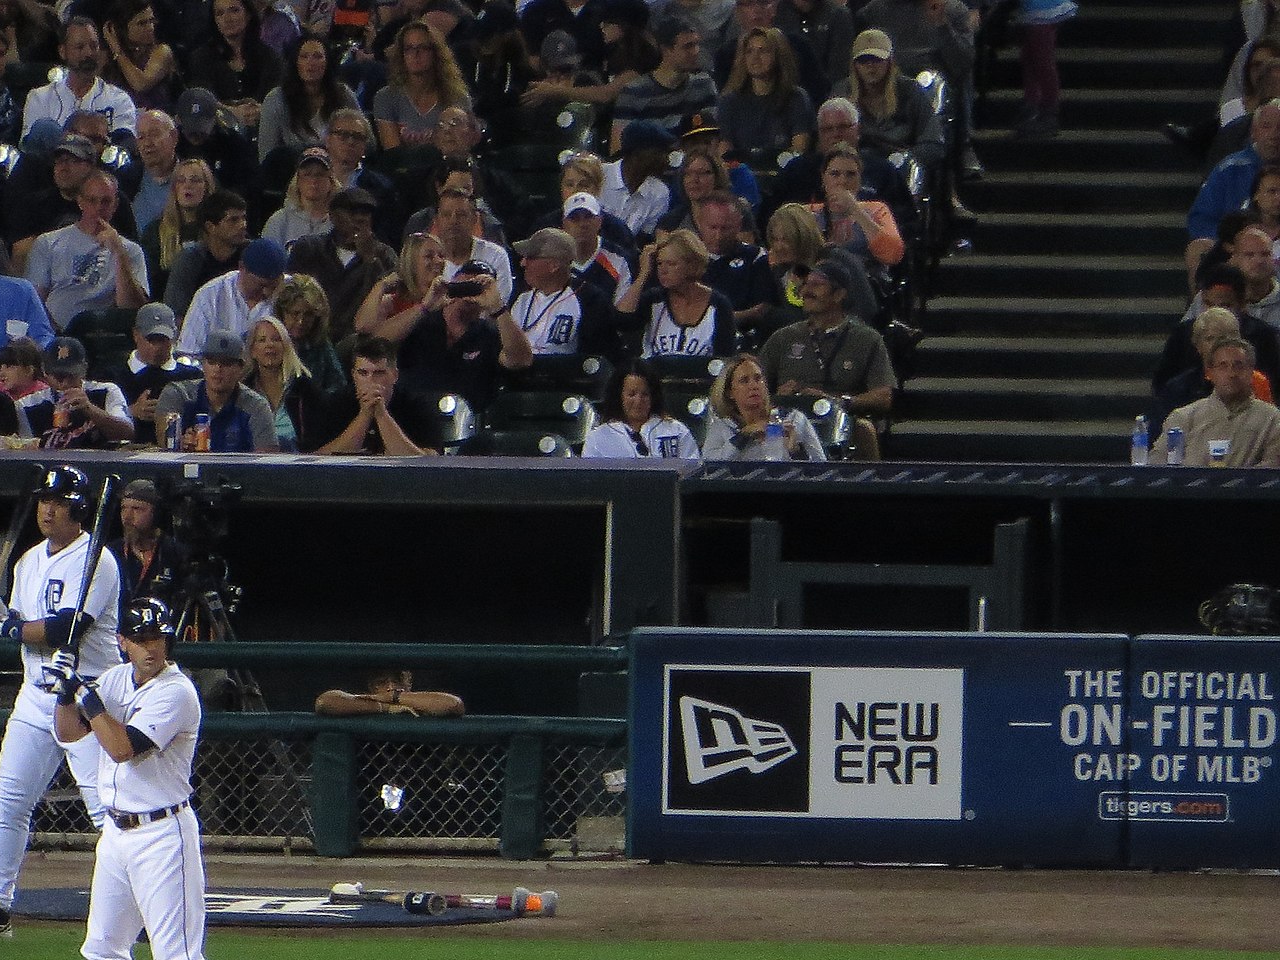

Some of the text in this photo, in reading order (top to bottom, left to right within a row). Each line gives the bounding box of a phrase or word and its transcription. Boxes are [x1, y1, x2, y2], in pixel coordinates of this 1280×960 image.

[1065, 670, 1274, 700] THE OFFICIAL
[834, 702, 939, 742] NEW
[834, 744, 939, 785] ERA
[1074, 753, 1141, 781] CAP
[1151, 754, 1188, 782] OF
[1106, 798, 1223, 817] tigers.com
